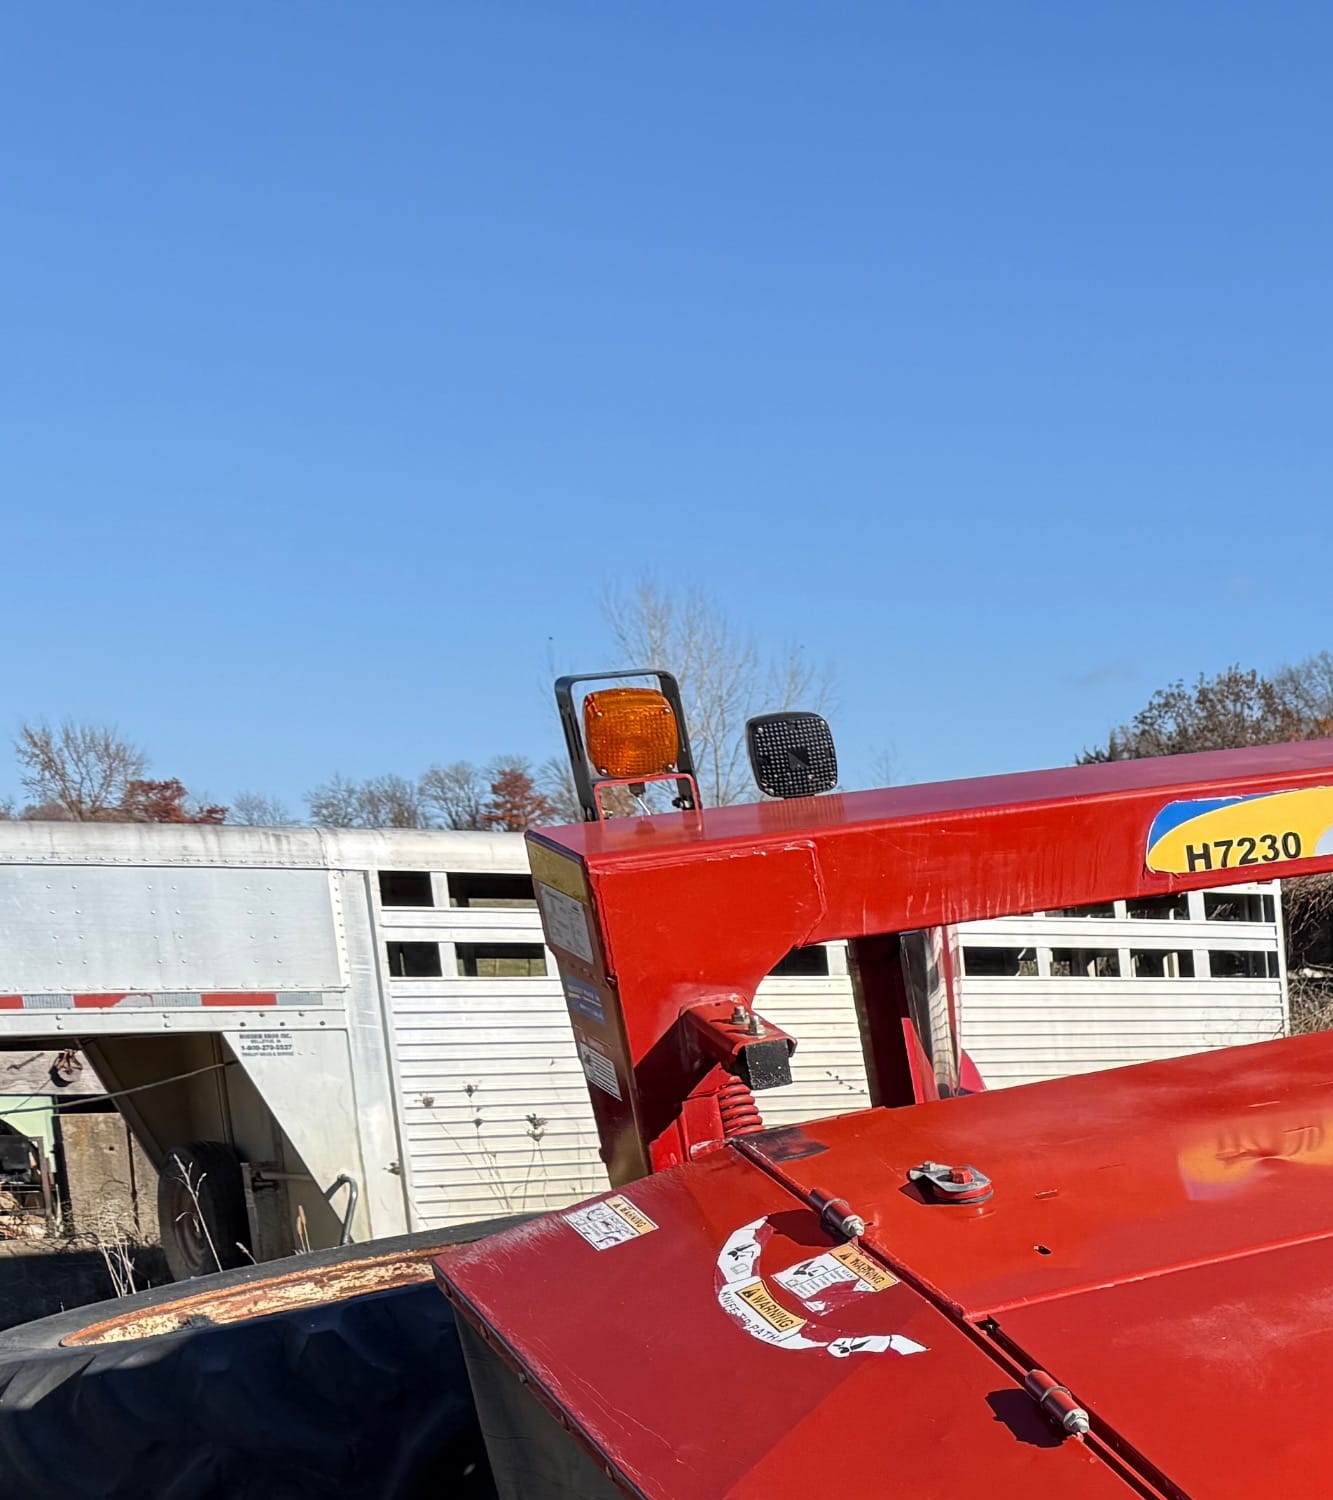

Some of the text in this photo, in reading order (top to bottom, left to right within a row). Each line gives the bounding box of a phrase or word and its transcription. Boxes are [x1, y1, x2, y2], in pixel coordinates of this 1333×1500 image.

[1185, 831, 1302, 872] H7230
[850, 1257, 886, 1286] WARNING
[751, 1294, 795, 1329] WARNING
